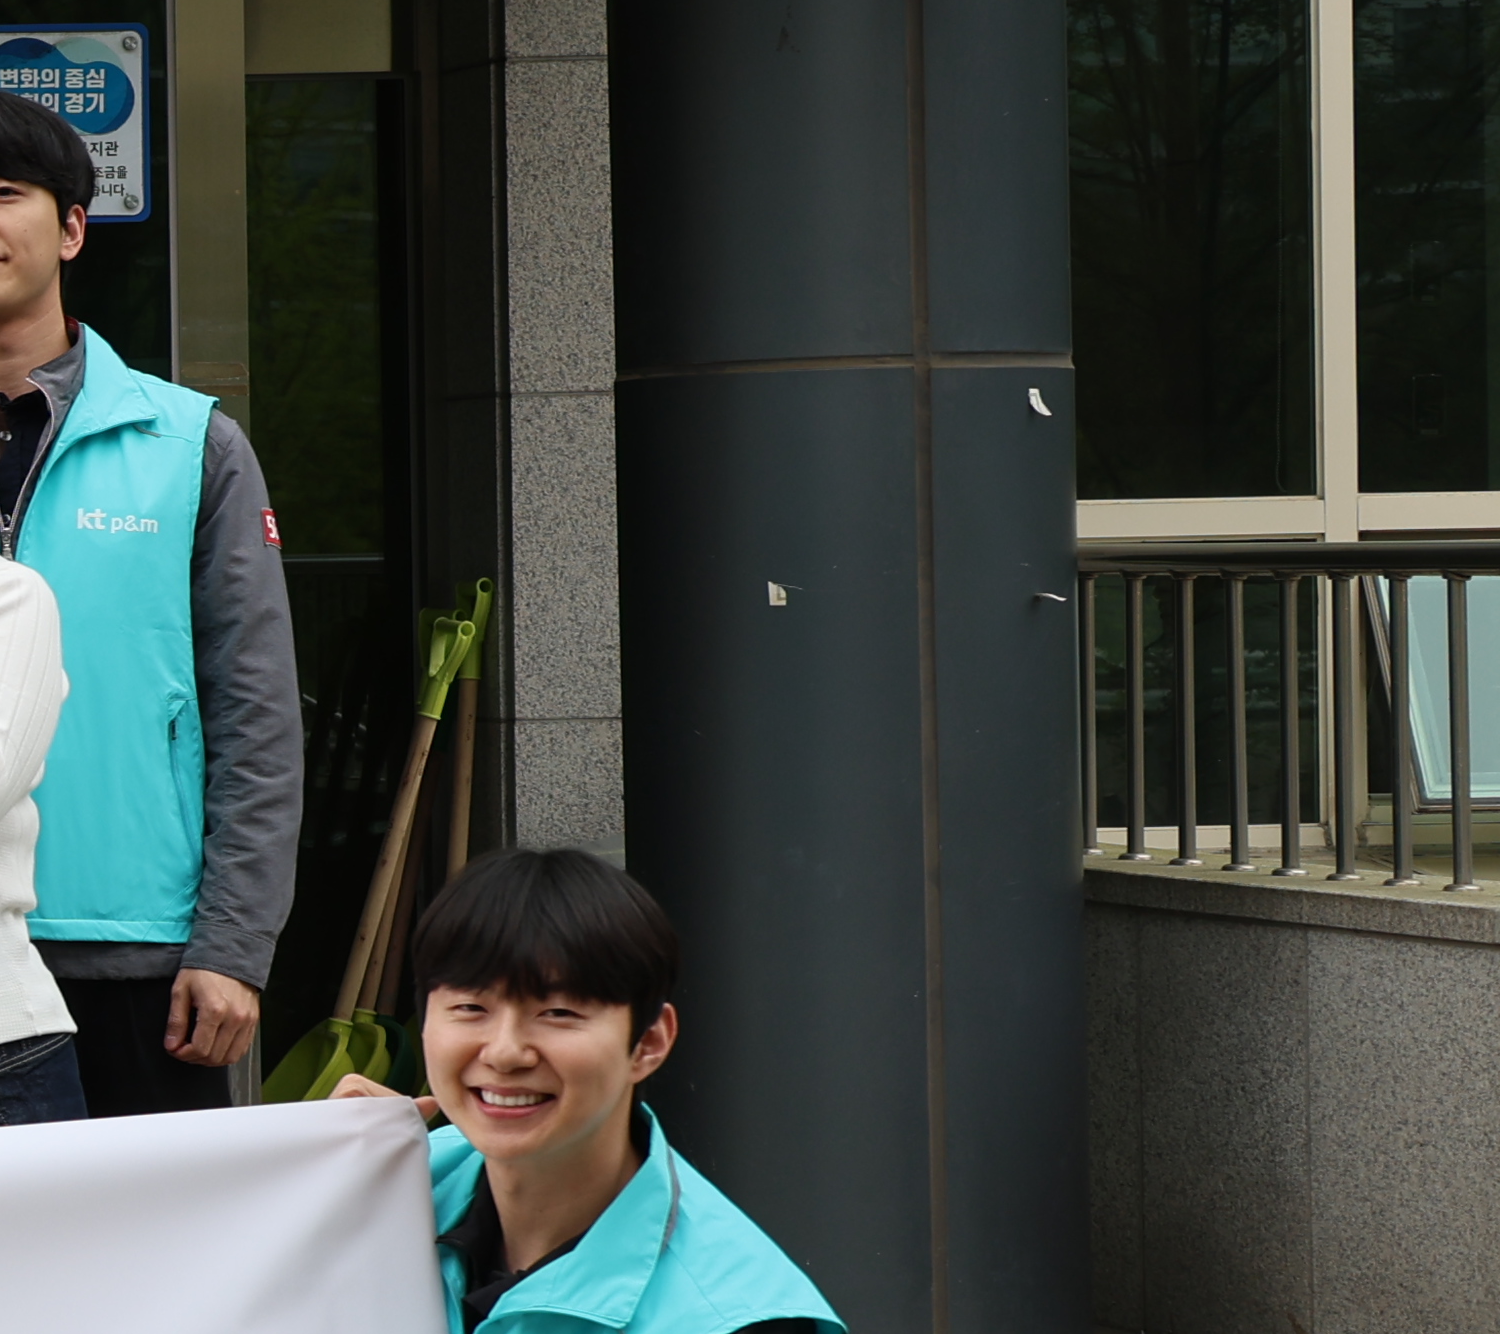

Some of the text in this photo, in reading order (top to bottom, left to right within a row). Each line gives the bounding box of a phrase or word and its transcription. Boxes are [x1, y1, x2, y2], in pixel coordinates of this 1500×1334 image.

[0, 68, 105, 88] 변화의 중심
[65, 93, 105, 114] 경기
[84, 142, 119, 157] 지관
[77, 508, 158, 534] kt p&m
